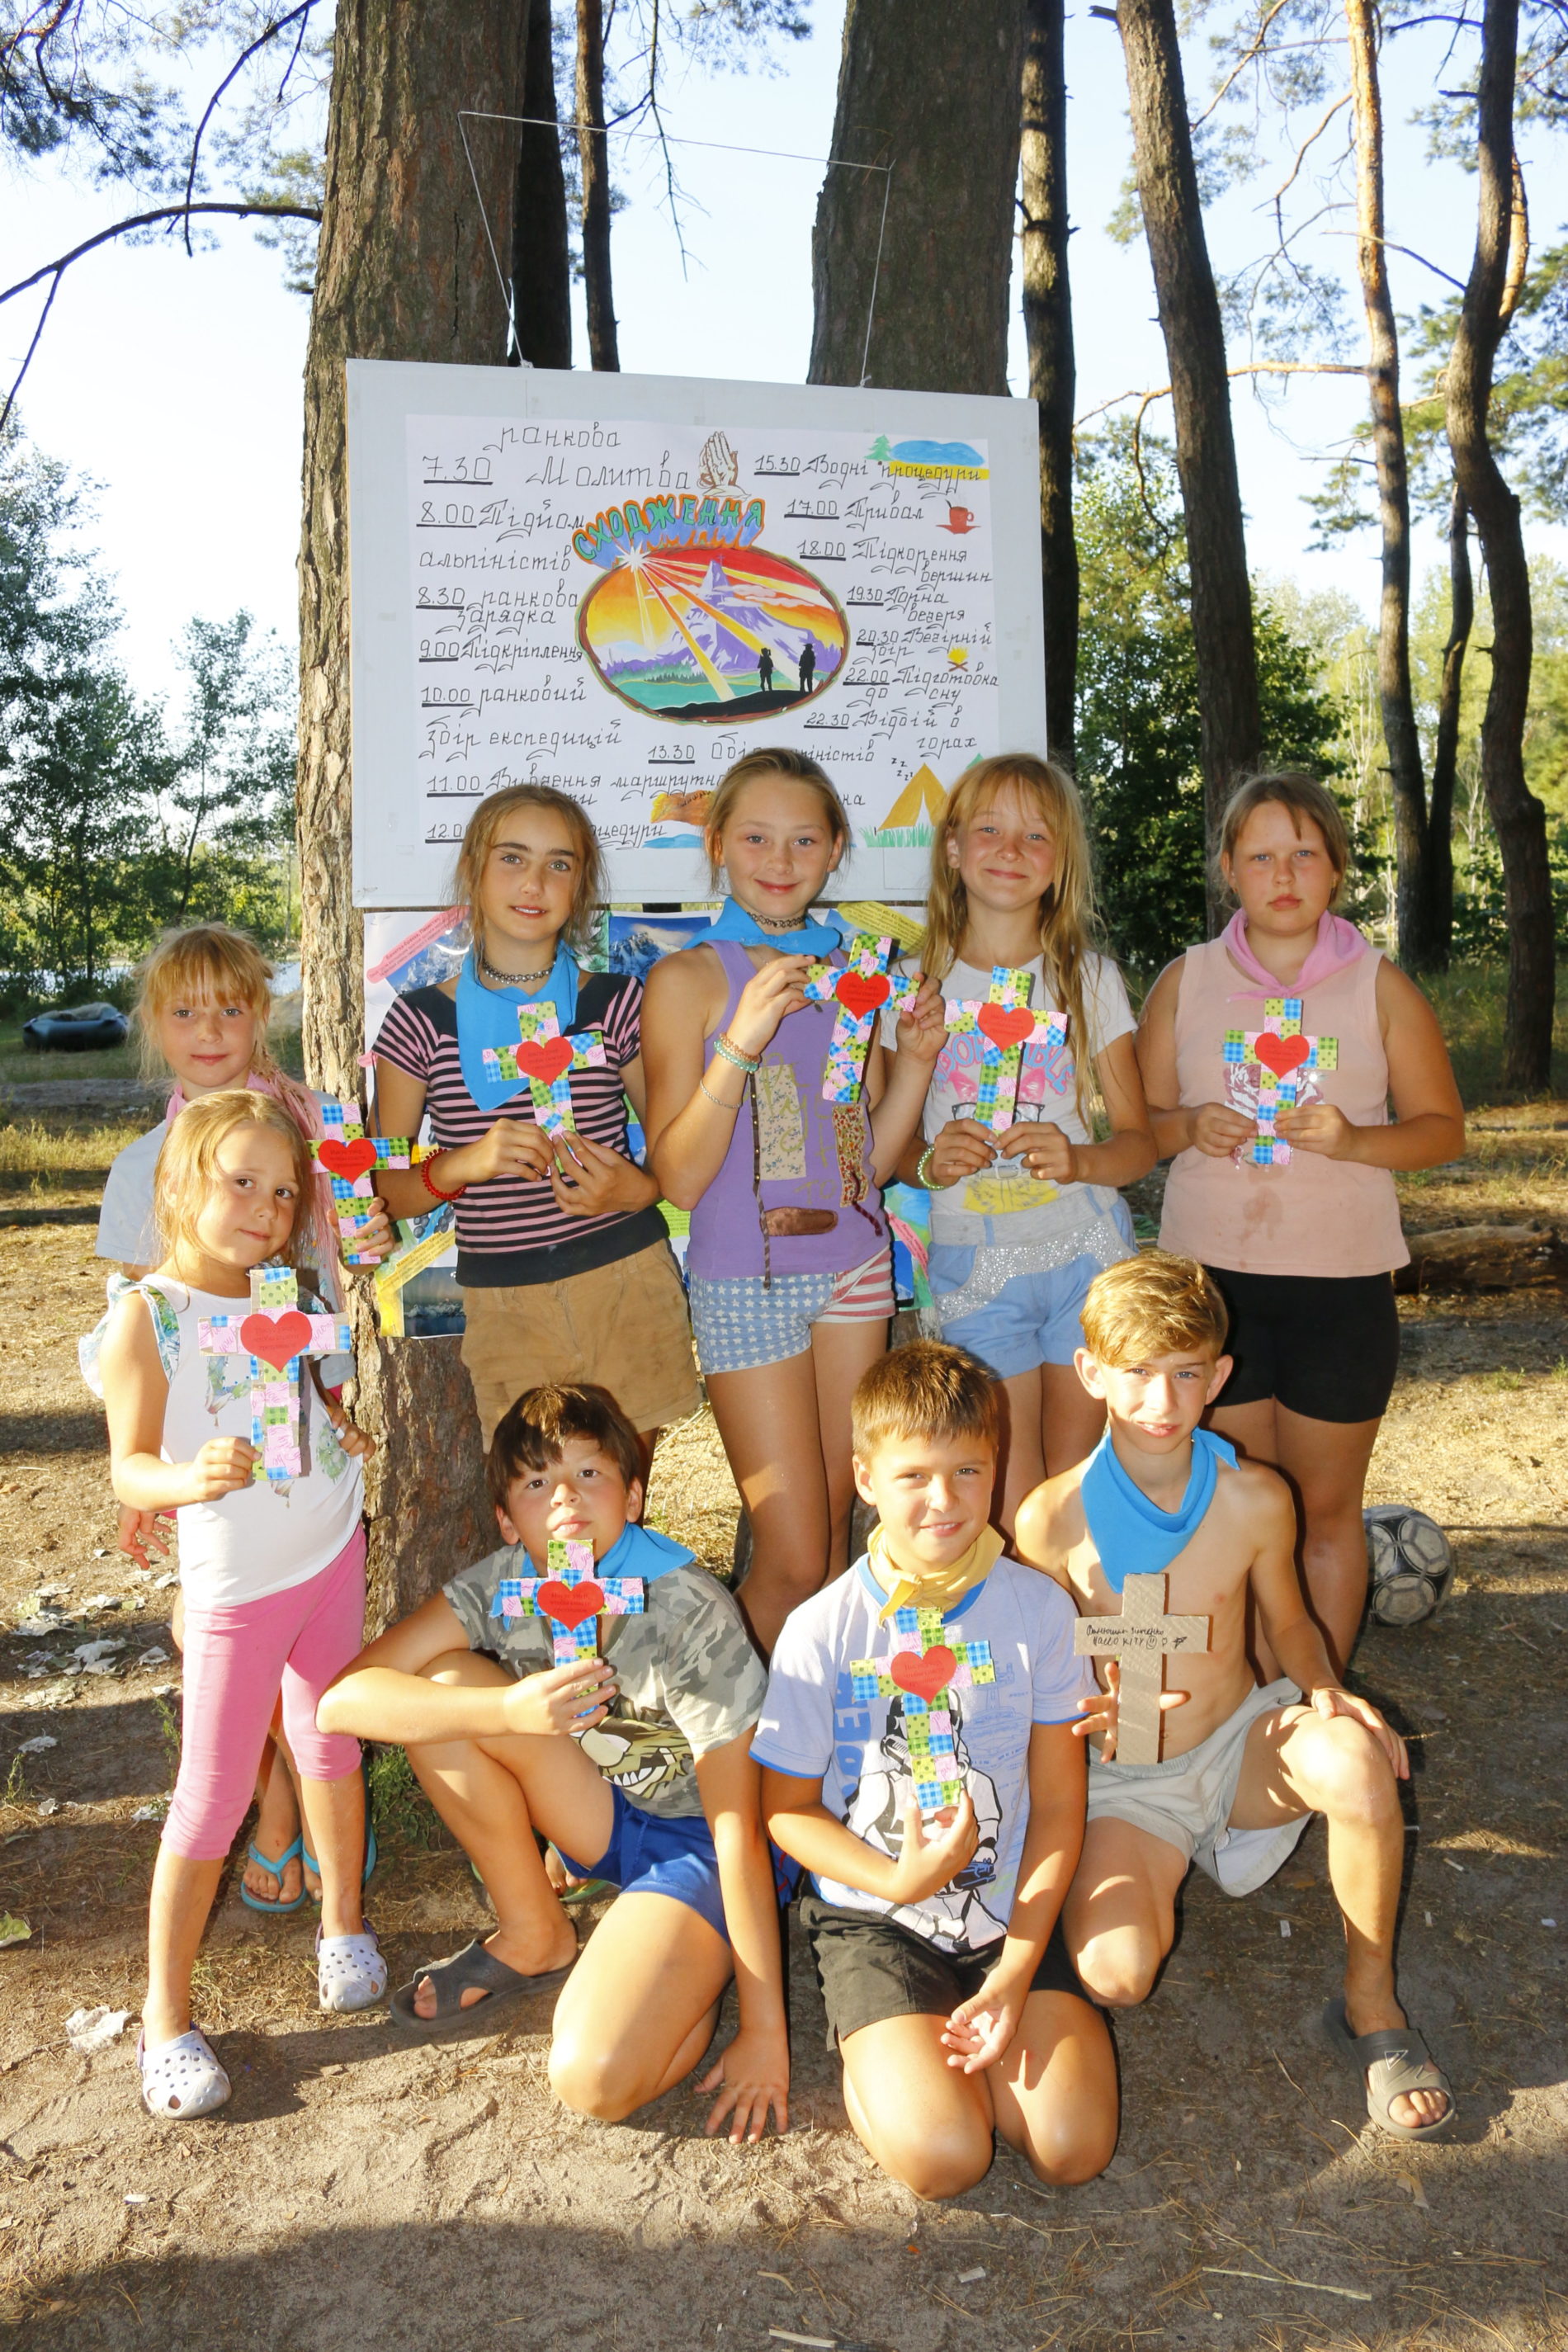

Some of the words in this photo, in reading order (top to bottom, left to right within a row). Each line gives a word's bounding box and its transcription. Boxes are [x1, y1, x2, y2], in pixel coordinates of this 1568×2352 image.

[483, 422, 621, 453] ранкова
[423, 456, 491, 480] 7.30
[526, 450, 690, 489] Молитва
[754, 455, 801, 473] 15.30
[802, 454, 868, 489] Водні
[870, 462, 983, 500] процедури
[421, 501, 475, 524] 8.00
[479, 498, 584, 543] Підйом
[786, 498, 838, 517] 17.00
[572, 494, 764, 561] СХОДЖЕННЯ
[419, 545, 572, 571] альпіністів
[797, 539, 846, 557] 18.00
[852, 536, 968, 575] Підкорення
[418, 587, 465, 606] 8.30
[466, 579, 579, 611] ранкова
[847, 586, 883, 602] 19.30
[435, 609, 556, 635] зарядка
[857, 629, 900, 644] 20.30
[901, 621, 992, 654] Вечірній
[419, 640, 460, 659] 9.00
[460, 633, 583, 675] Підкріплення
[845, 668, 889, 683] 22.00
[892, 662, 999, 697] Підготовка
[422, 686, 470, 703] 10.00
[460, 675, 587, 718] ранковий
[847, 687, 888, 708] до
[928, 687, 961, 708] сну
[489, 718, 622, 761] експедицій
[806, 712, 850, 726] 22.30
[852, 707, 938, 740] Відбій
[648, 744, 696, 760] 13.30
[711, 732, 762, 759] Обі
[916, 736, 978, 760] горах
[427, 775, 481, 792] 11.00
[427, 824, 469, 838] 12.0
